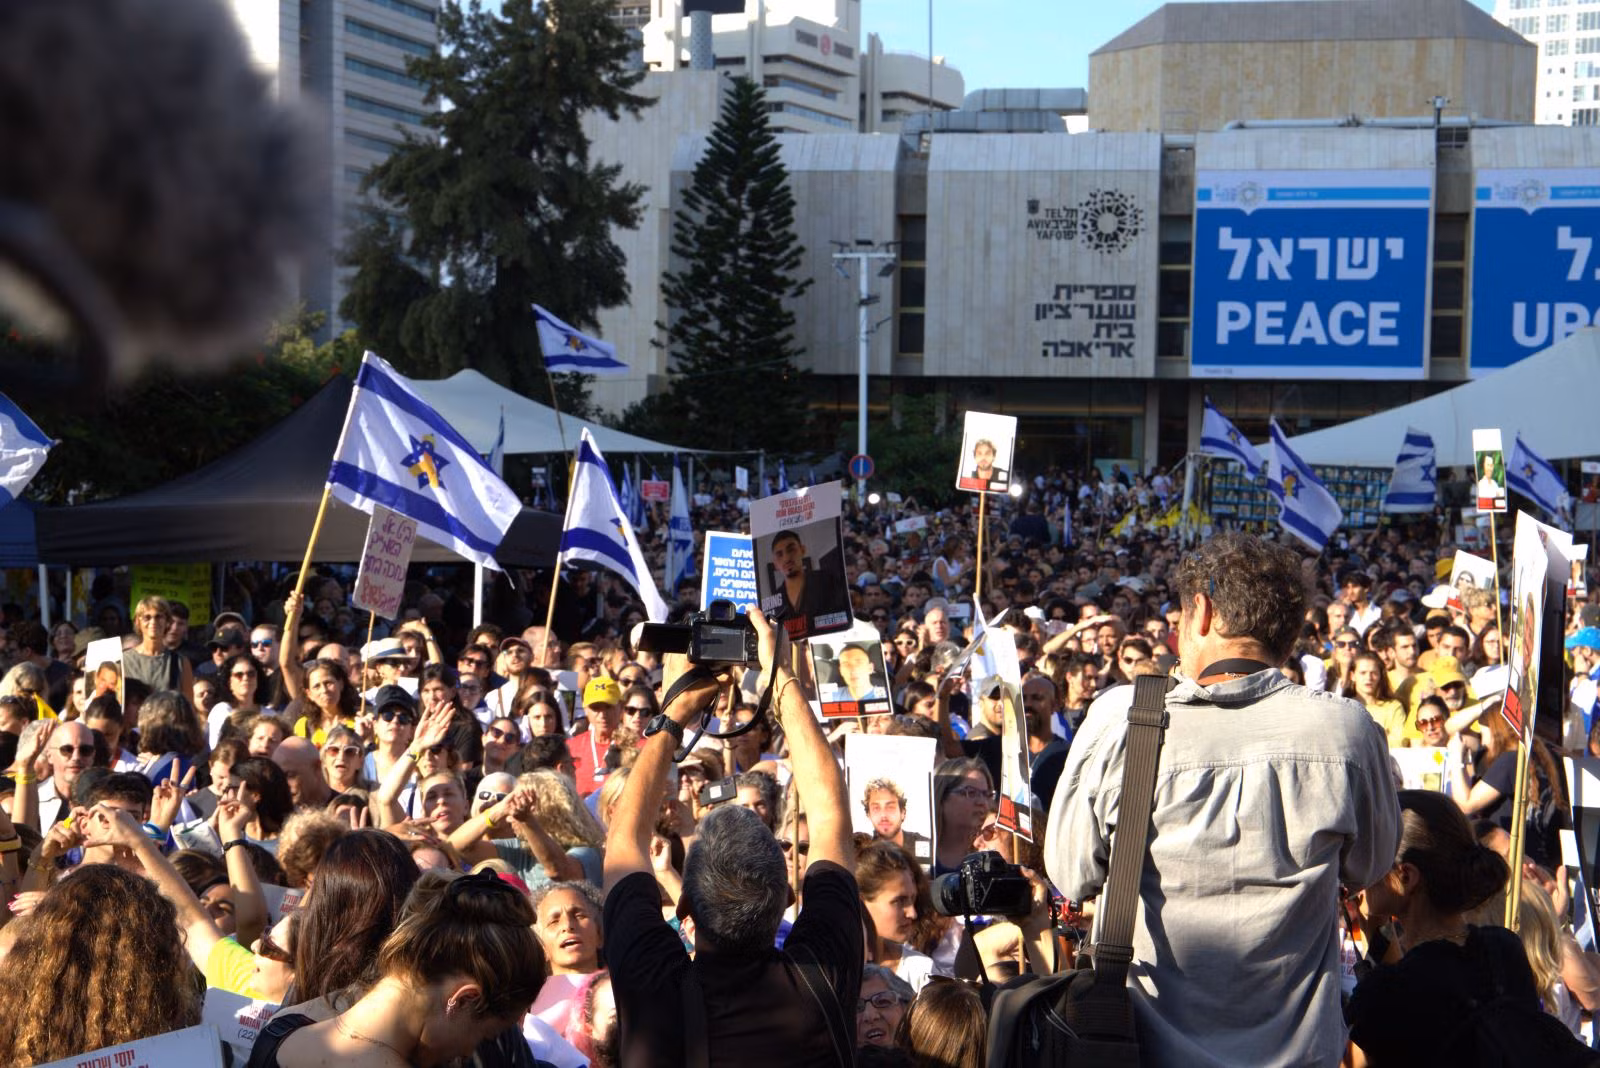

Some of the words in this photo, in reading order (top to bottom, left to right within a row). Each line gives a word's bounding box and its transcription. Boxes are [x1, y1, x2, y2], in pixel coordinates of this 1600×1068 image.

[1045, 208, 1062, 218] TEL
[1063, 206, 1078, 218] תל
[1027, 219, 1050, 229] AVIV
[1050, 219, 1078, 229] אביב
[1036, 230, 1060, 240] YAFO
[1218, 227, 1404, 281] ישראל
[1053, 284, 1136, 301] ספריית
[1093, 322, 1136, 339] בית
[1216, 301, 1400, 346] PEACE
[1042, 340, 1135, 358] אריאלה
[239, 1014, 261, 1031] MATAN
[114, 1048, 135, 1068] יוסי
